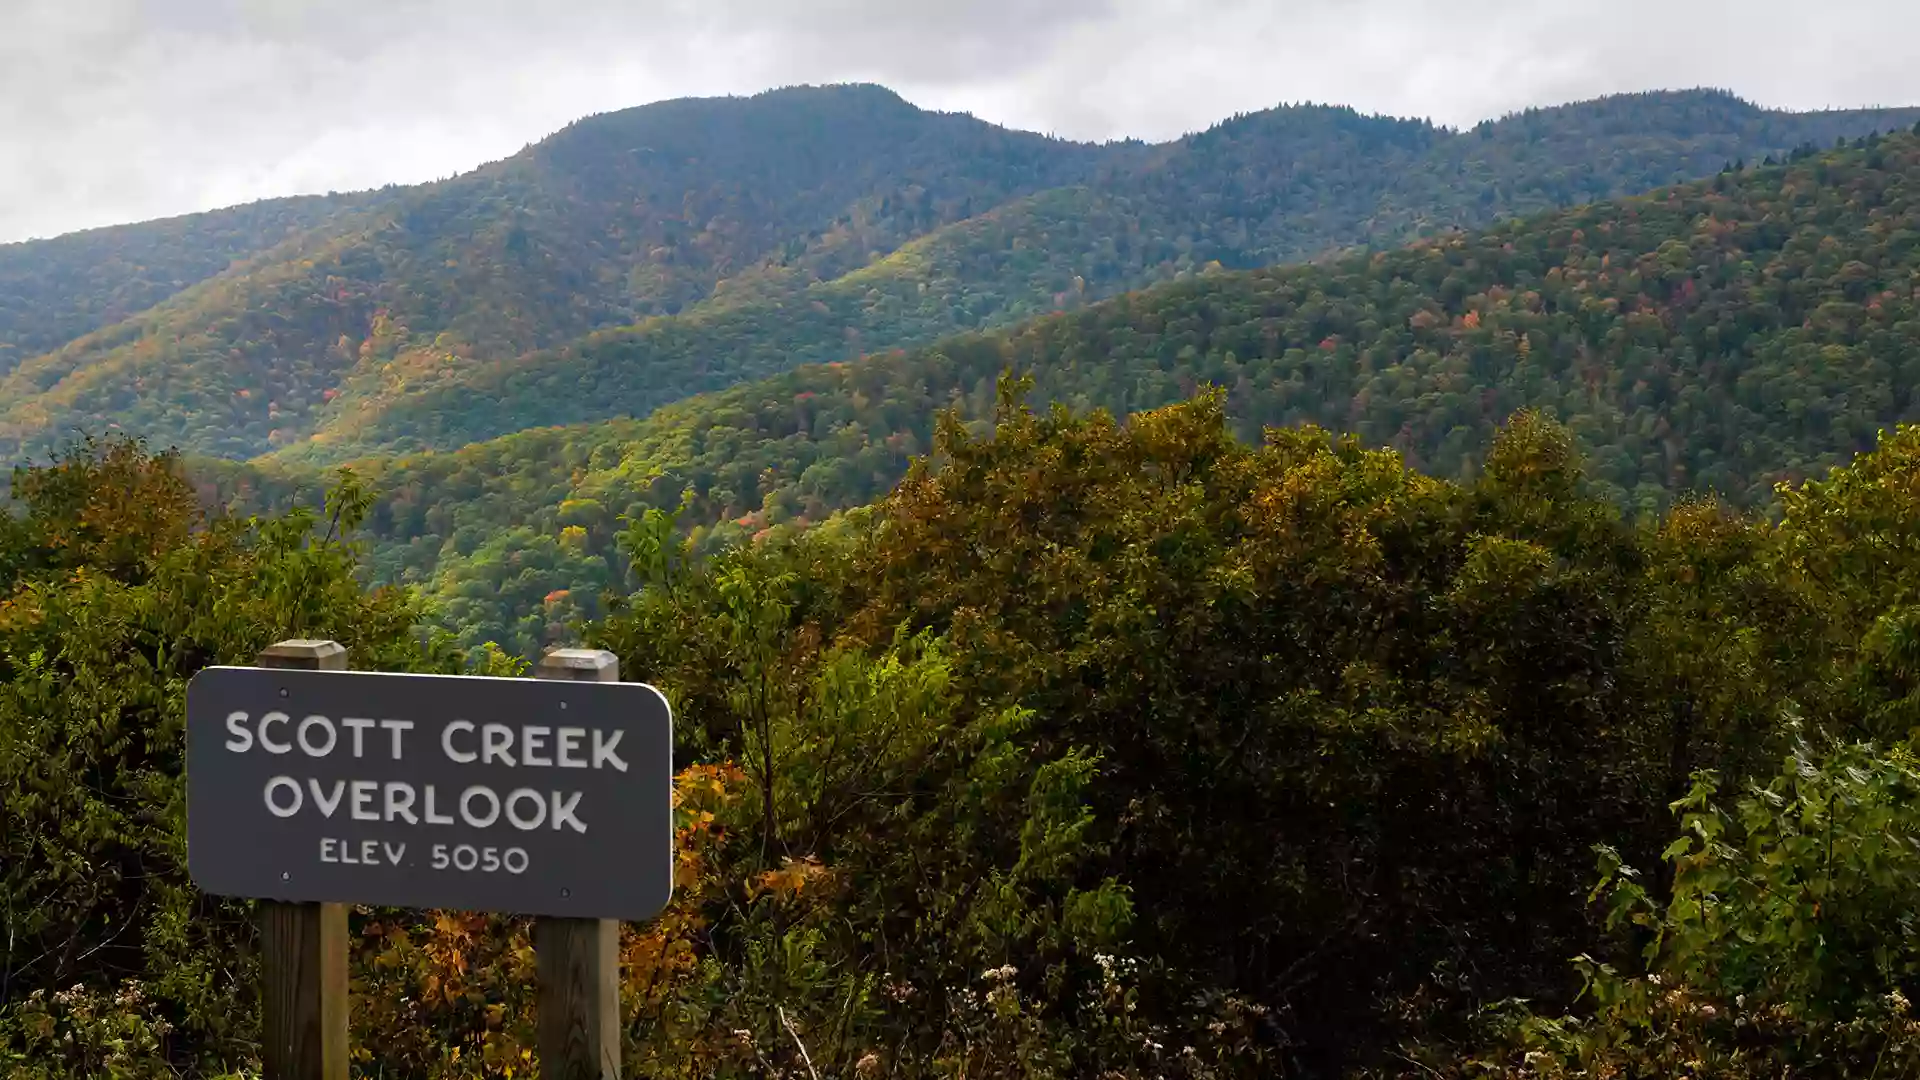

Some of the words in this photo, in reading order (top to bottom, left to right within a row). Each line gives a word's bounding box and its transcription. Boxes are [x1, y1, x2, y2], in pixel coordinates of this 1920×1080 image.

[225, 711, 415, 759] SCOTT
[441, 720, 629, 772] CREEK
[264, 775, 588, 834] OVERLOOK
[431, 844, 530, 874] 5050
